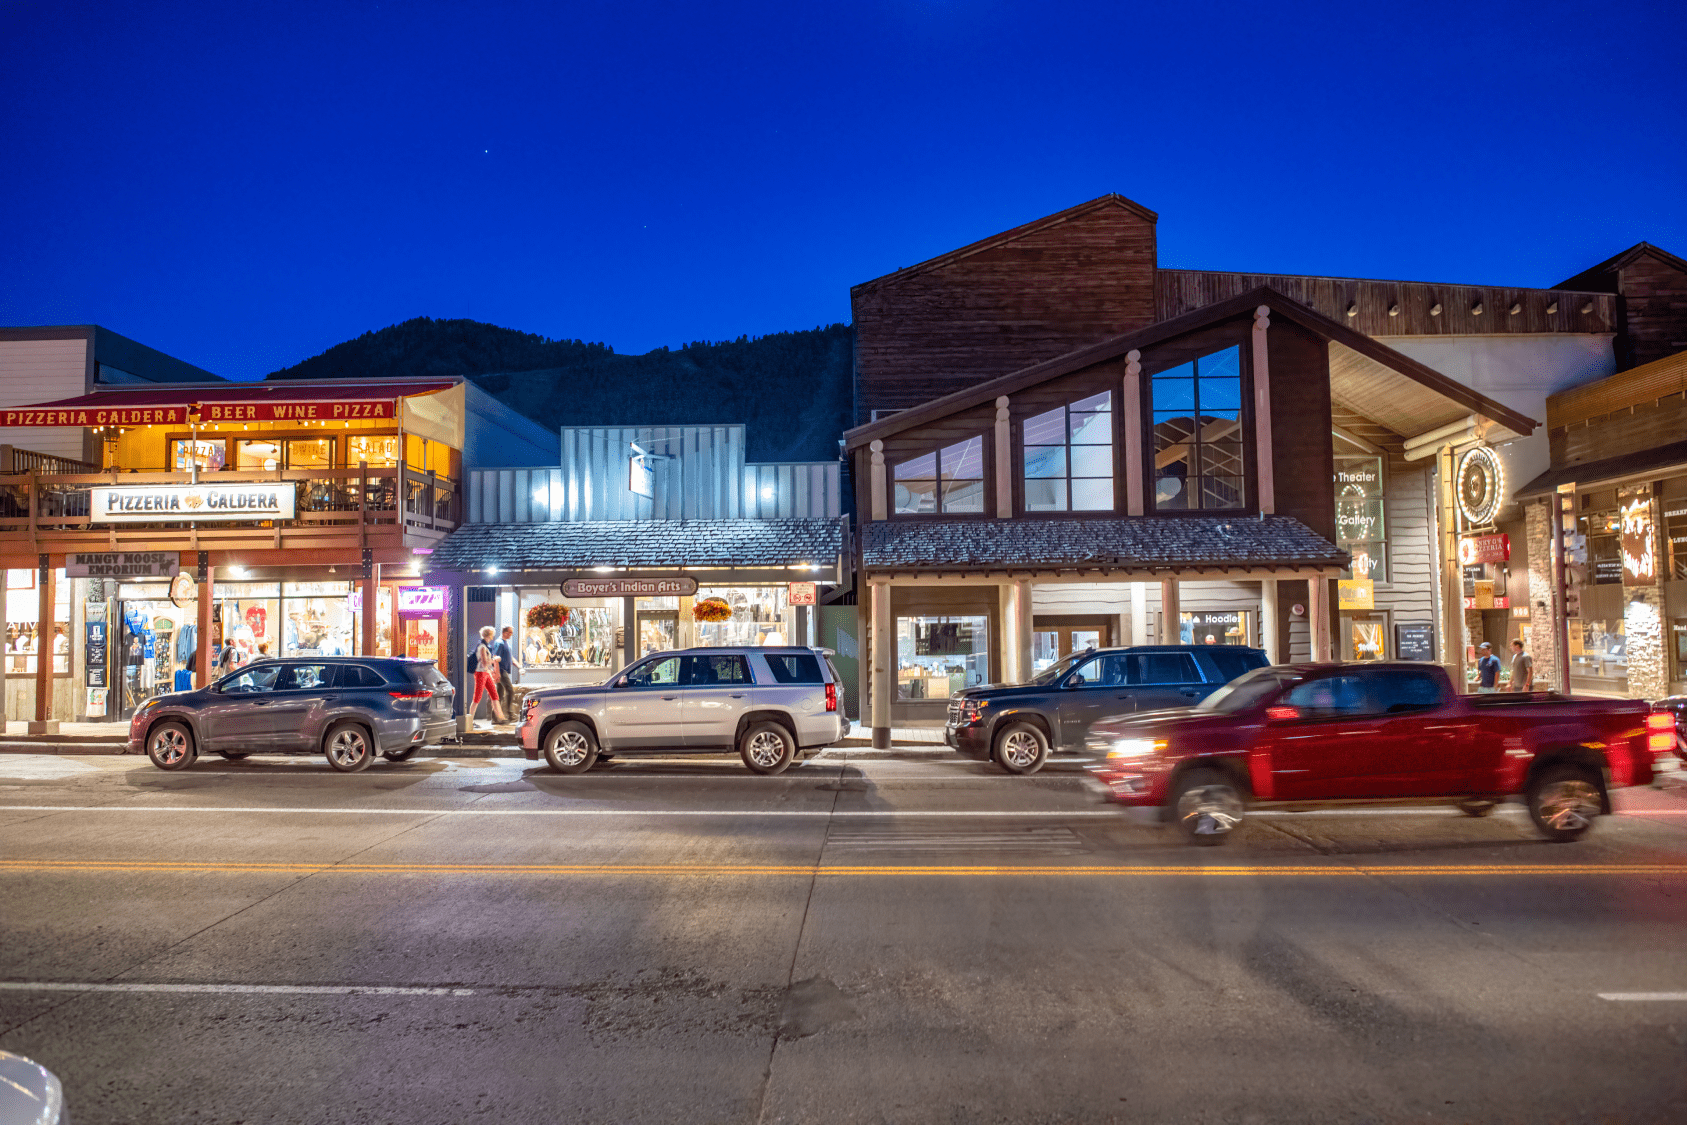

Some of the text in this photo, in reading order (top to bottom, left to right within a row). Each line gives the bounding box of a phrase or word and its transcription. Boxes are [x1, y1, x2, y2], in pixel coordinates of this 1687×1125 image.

[7, 409, 177, 425] PIZZERIA CALDERA
[211, 404, 384, 419] BEER WINE PIZZA
[184, 445, 214, 457] PIZZA
[357, 441, 392, 454] SALAD
[1338, 471, 1375, 483] Theater
[107, 490, 279, 511] PIZZERIA CALDERA
[1339, 514, 1376, 527] Gallery
[75, 553, 166, 565] MANGY MOOSE
[88, 564, 152, 575] EMPORIUM
[577, 581, 681, 595] Boyer's Indian Arts
[1205, 613, 1242, 624] Hoodies
